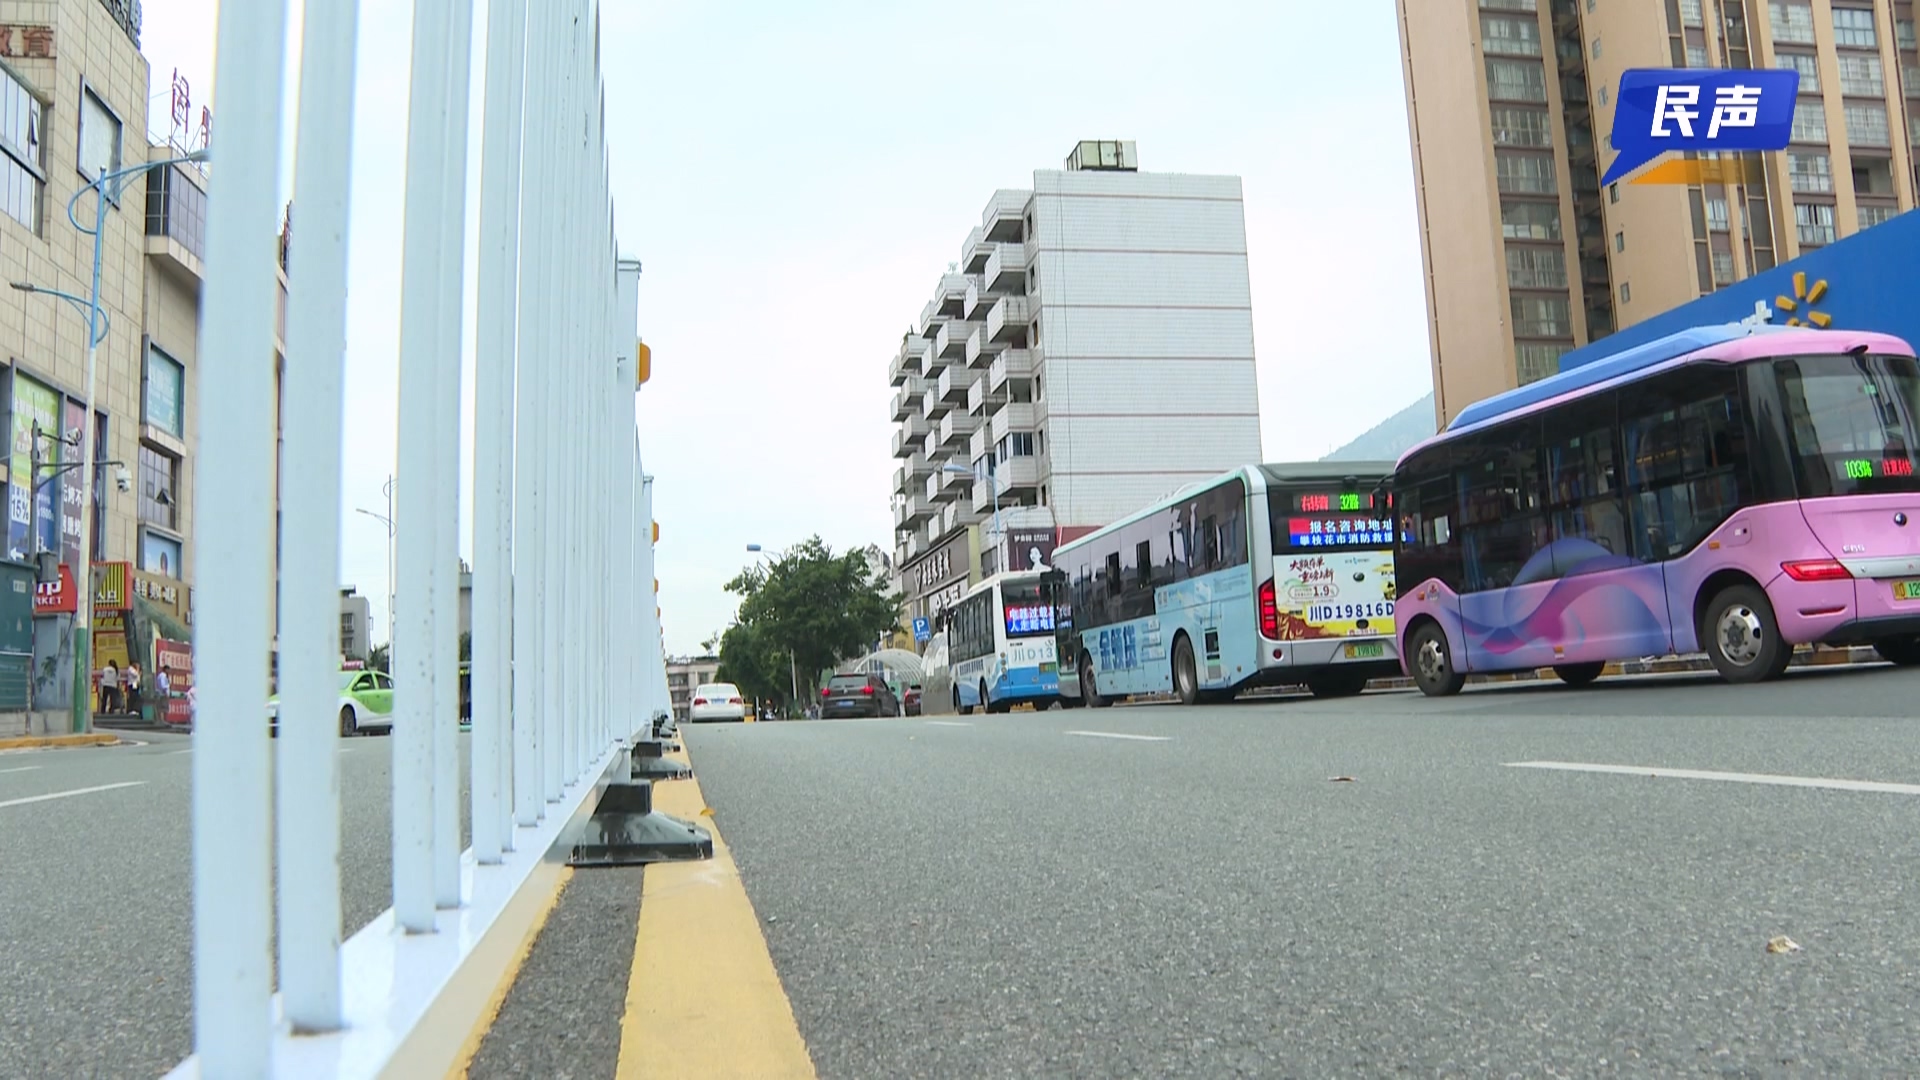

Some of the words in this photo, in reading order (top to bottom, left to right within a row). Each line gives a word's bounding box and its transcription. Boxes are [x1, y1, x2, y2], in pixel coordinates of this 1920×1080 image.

[1310, 519, 1393, 533] 报名咨询地址
[1310, 603, 1395, 622] 川D19816D
[915, 619, 926, 635] P
